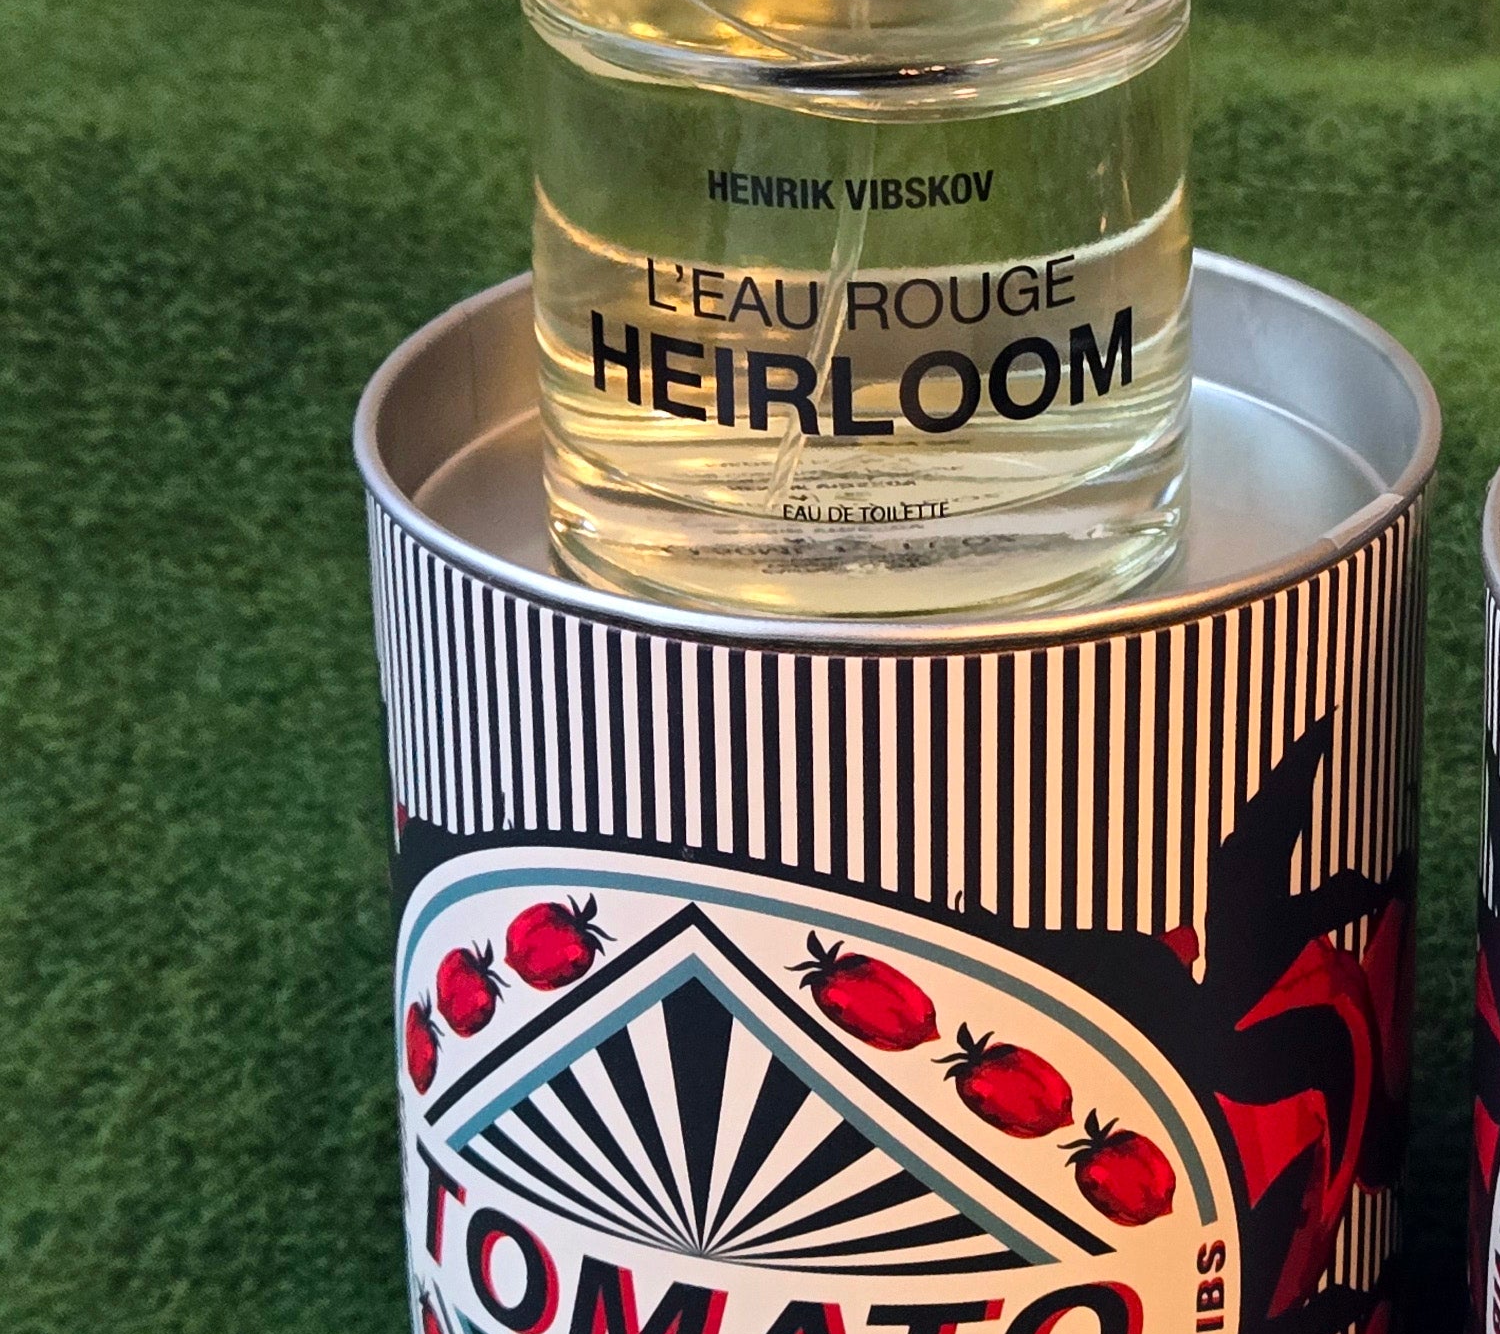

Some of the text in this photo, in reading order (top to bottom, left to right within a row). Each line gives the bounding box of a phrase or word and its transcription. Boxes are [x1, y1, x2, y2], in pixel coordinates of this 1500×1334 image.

[707, 169, 994, 210] HENRIK VIBSKOV
[847, 254, 1076, 330] ROUGE
[590, 305, 1133, 437] HEIRLOOM
[783, 501, 949, 523] EAU DE TOILETTE
